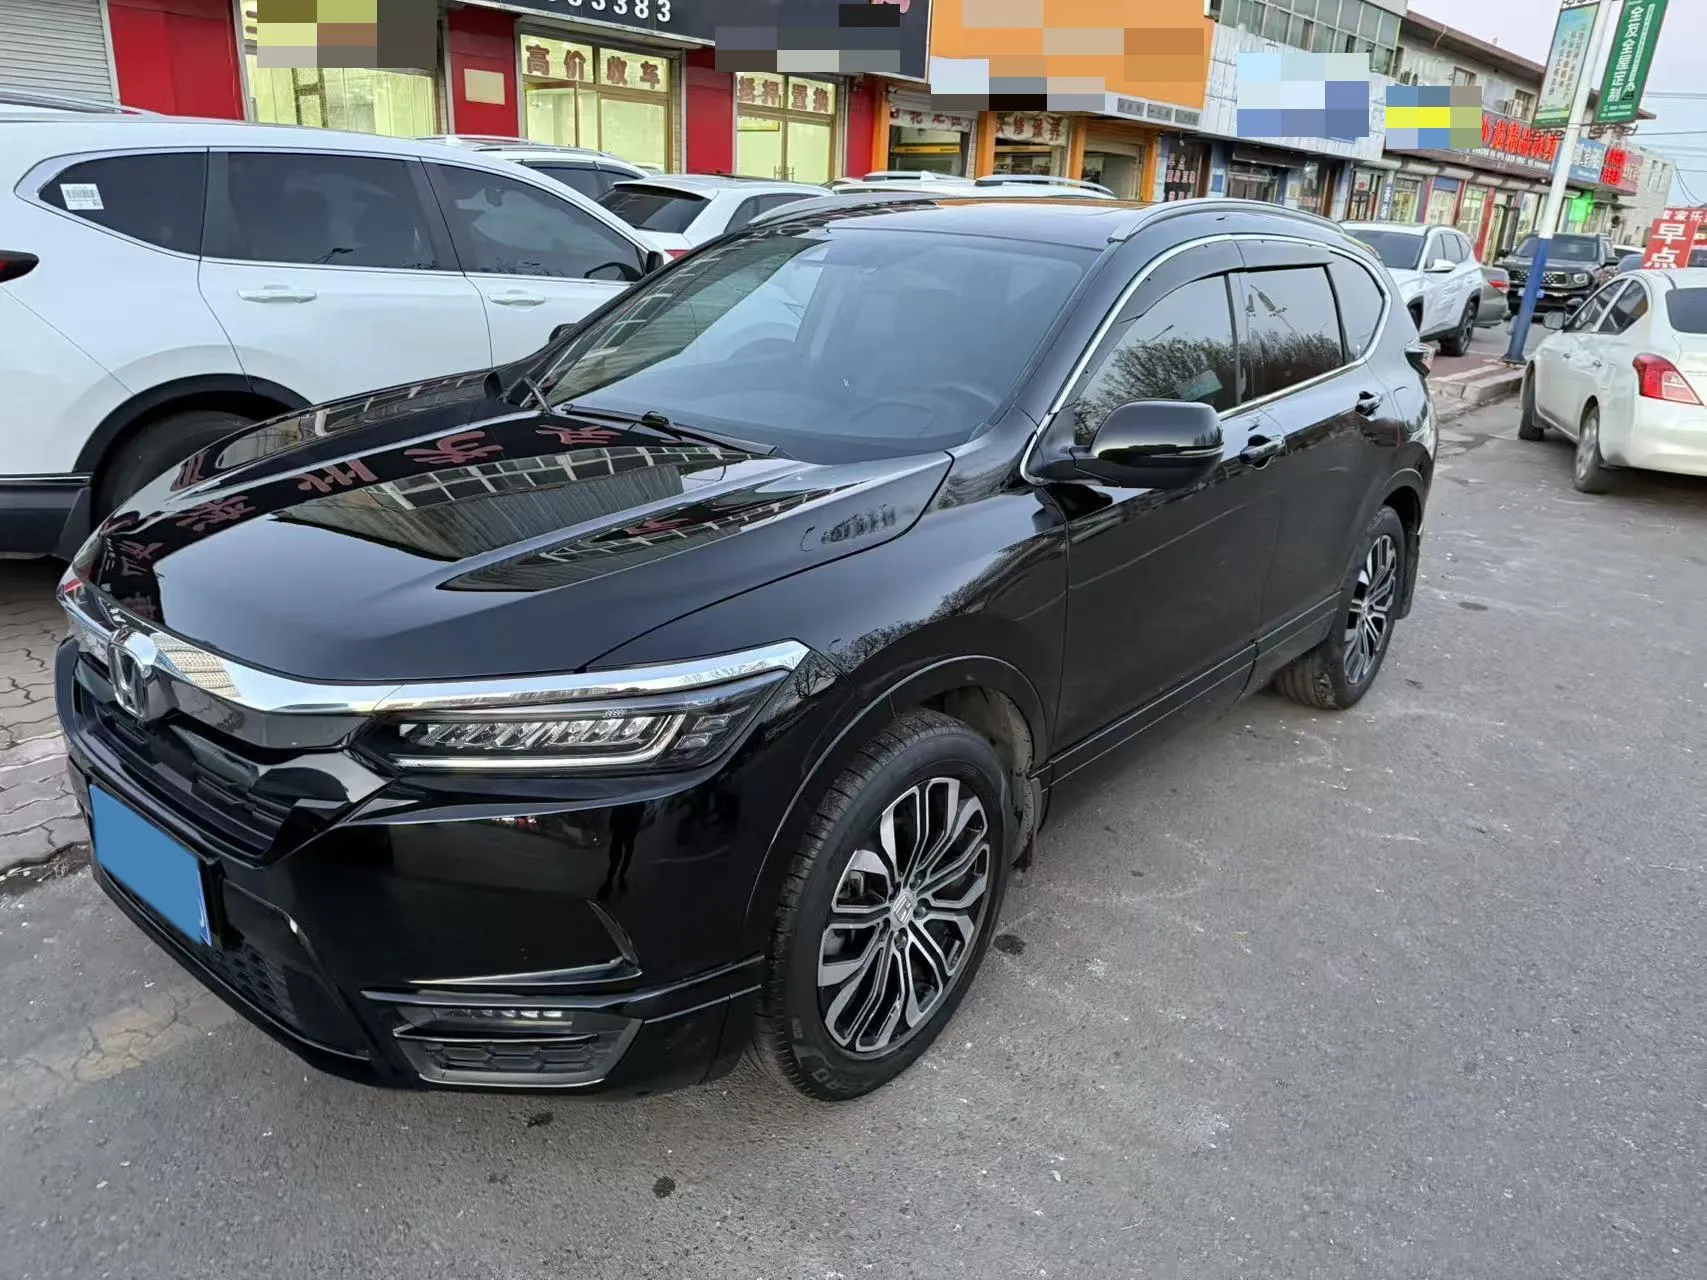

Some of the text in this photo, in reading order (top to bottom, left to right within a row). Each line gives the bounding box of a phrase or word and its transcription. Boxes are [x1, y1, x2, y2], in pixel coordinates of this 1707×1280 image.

[525, 44, 660, 89] 高价收车
[1642, 223, 1687, 269] 早点
